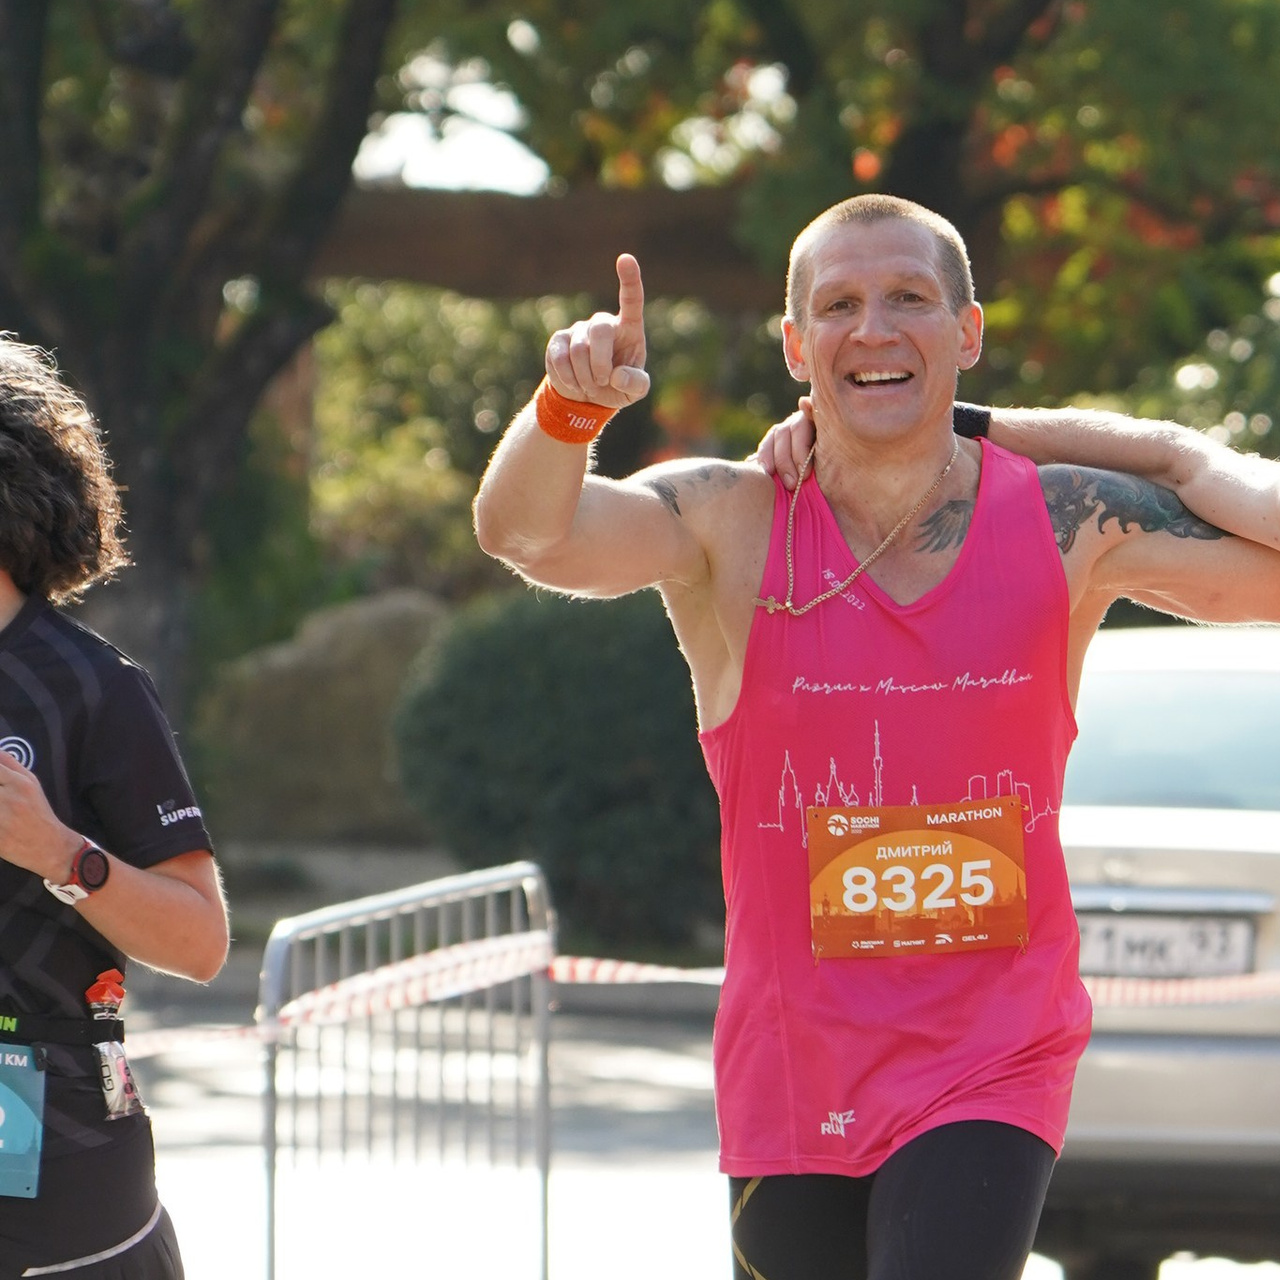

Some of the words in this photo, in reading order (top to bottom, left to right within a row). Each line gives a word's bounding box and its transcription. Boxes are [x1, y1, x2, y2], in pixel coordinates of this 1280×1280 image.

[875, 676, 949, 696] Moscow
[952, 668, 1033, 692] Marathon
[850, 815, 880, 825] SOCHI
[926, 806, 1003, 826] MARATHON
[875, 840, 953, 861] ДМИТРИЙ
[841, 859, 995, 915] 8325
